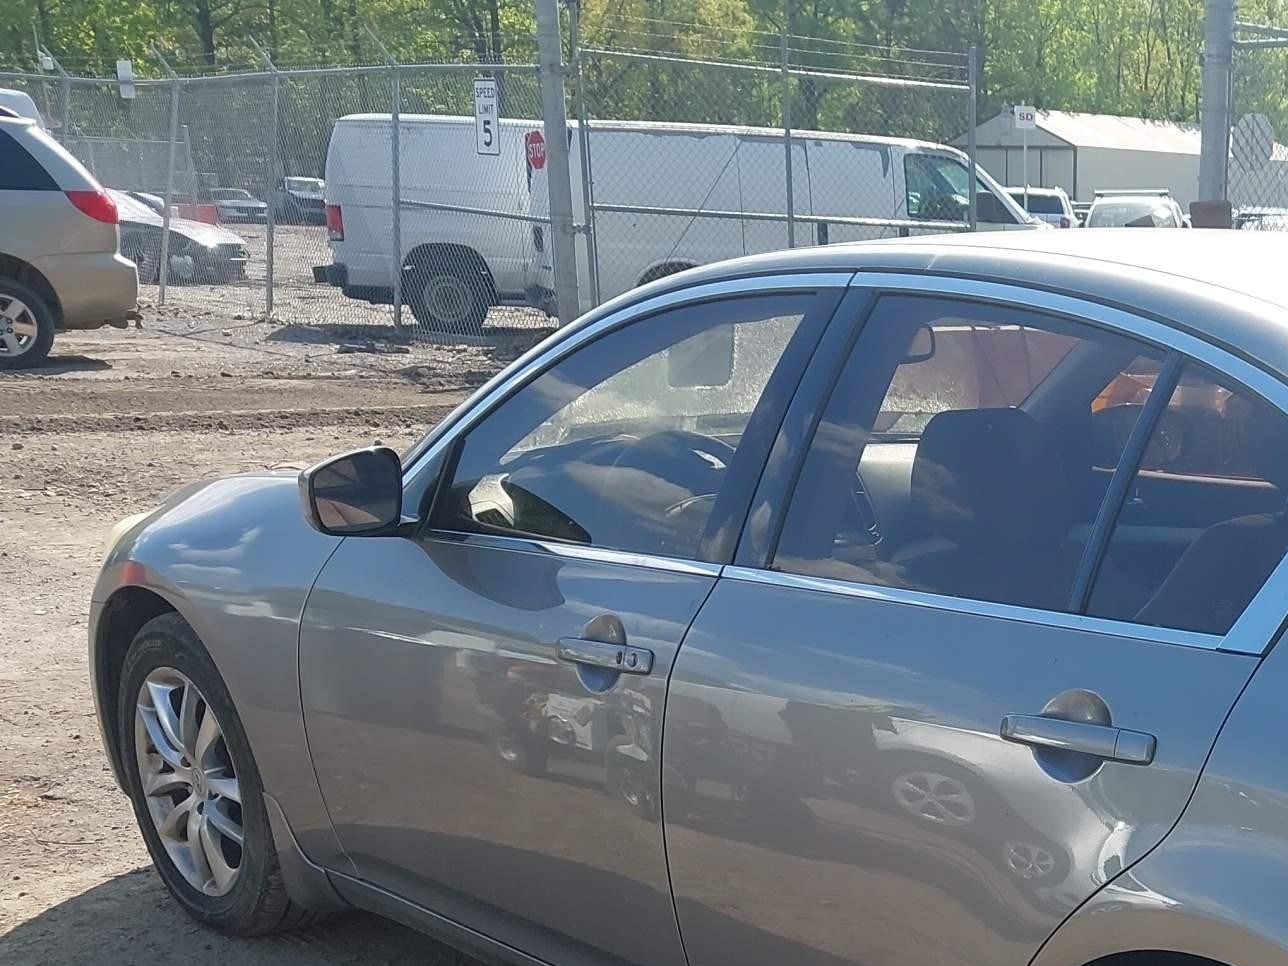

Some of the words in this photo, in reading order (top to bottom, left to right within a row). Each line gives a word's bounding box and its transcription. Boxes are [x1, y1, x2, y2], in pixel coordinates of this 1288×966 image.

[475, 87, 495, 98] SPEED
[478, 104, 494, 114] LIMIT
[482, 120, 492, 146] 5
[528, 143, 545, 158] STOP
